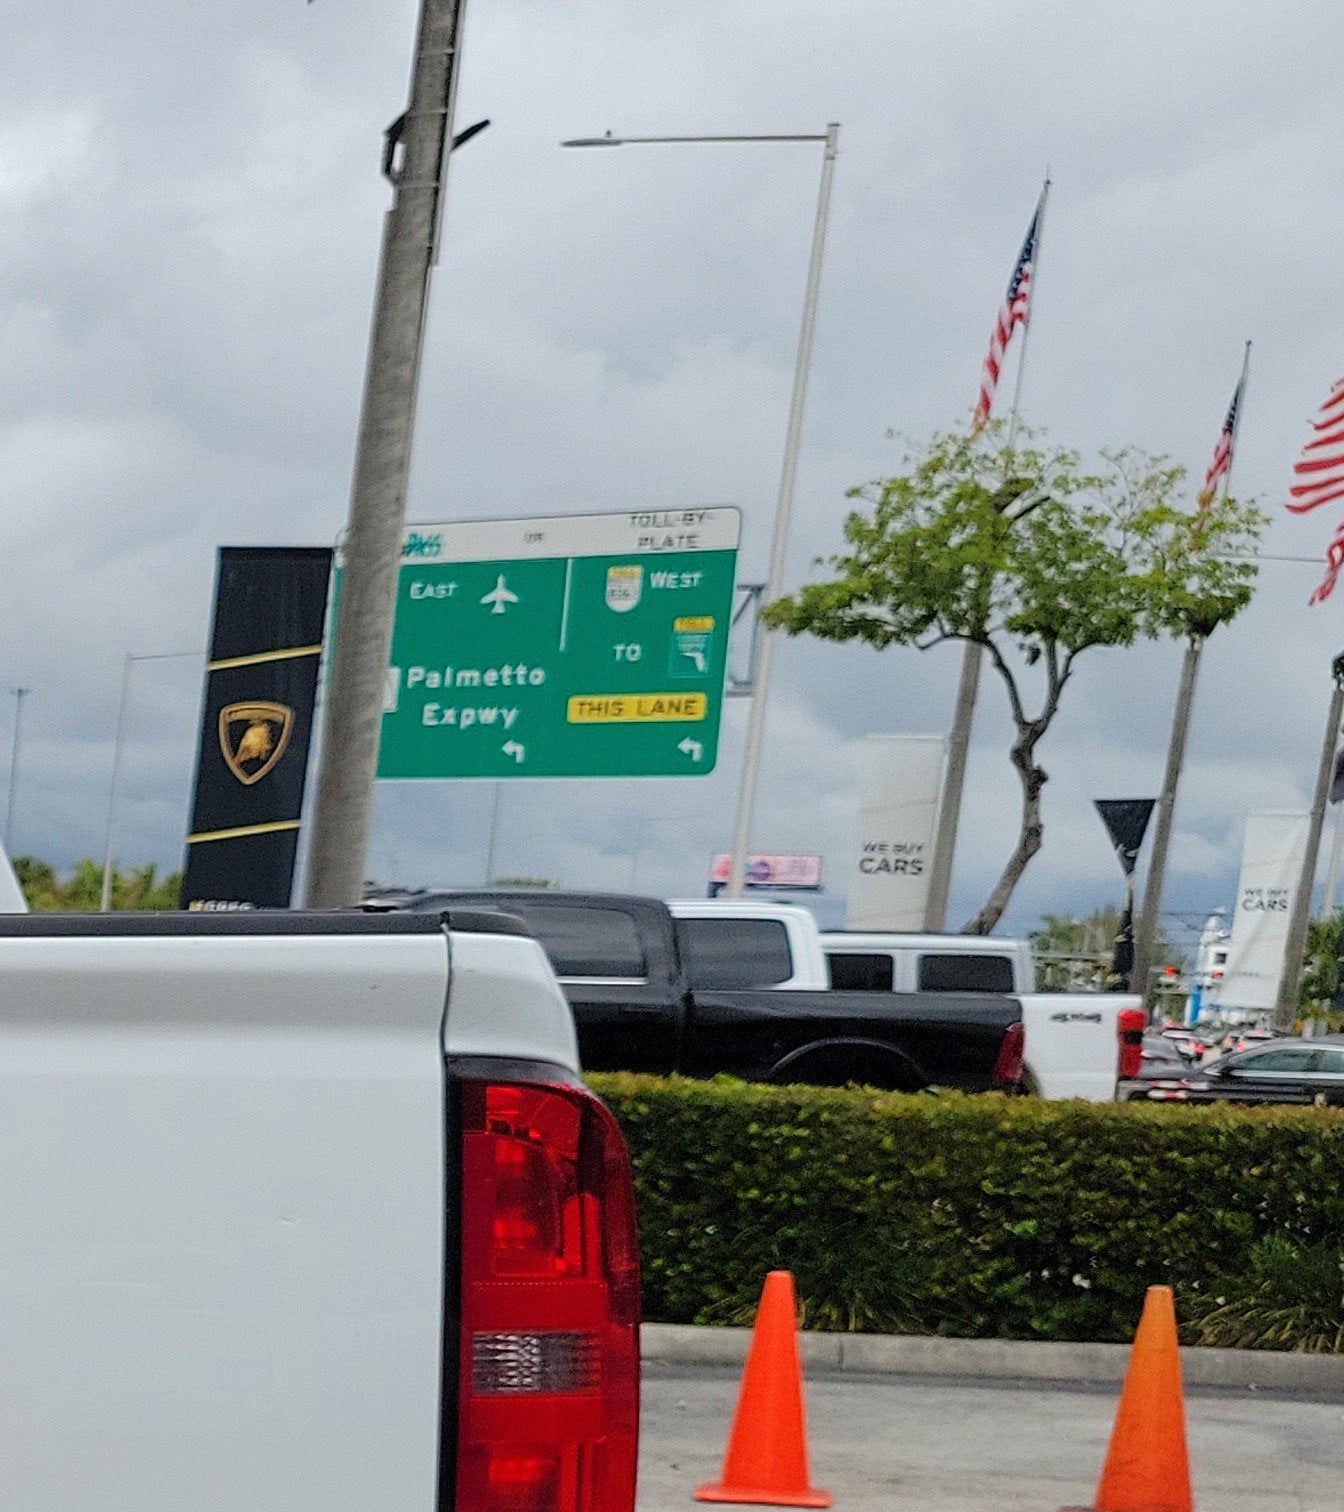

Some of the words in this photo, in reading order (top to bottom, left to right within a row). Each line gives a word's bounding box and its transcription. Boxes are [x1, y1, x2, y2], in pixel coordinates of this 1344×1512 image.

[638, 534, 699, 550] PLATE
[650, 571, 703, 589] WEST
[410, 581, 459, 599] EAST
[613, 643, 642, 662] TO
[407, 663, 546, 688] Palmetto
[422, 702, 519, 730] Expwy
[575, 700, 624, 717] THIS
[637, 698, 698, 717] LANE
[859, 858, 923, 875] CARS
[1242, 899, 1289, 912] CARS
